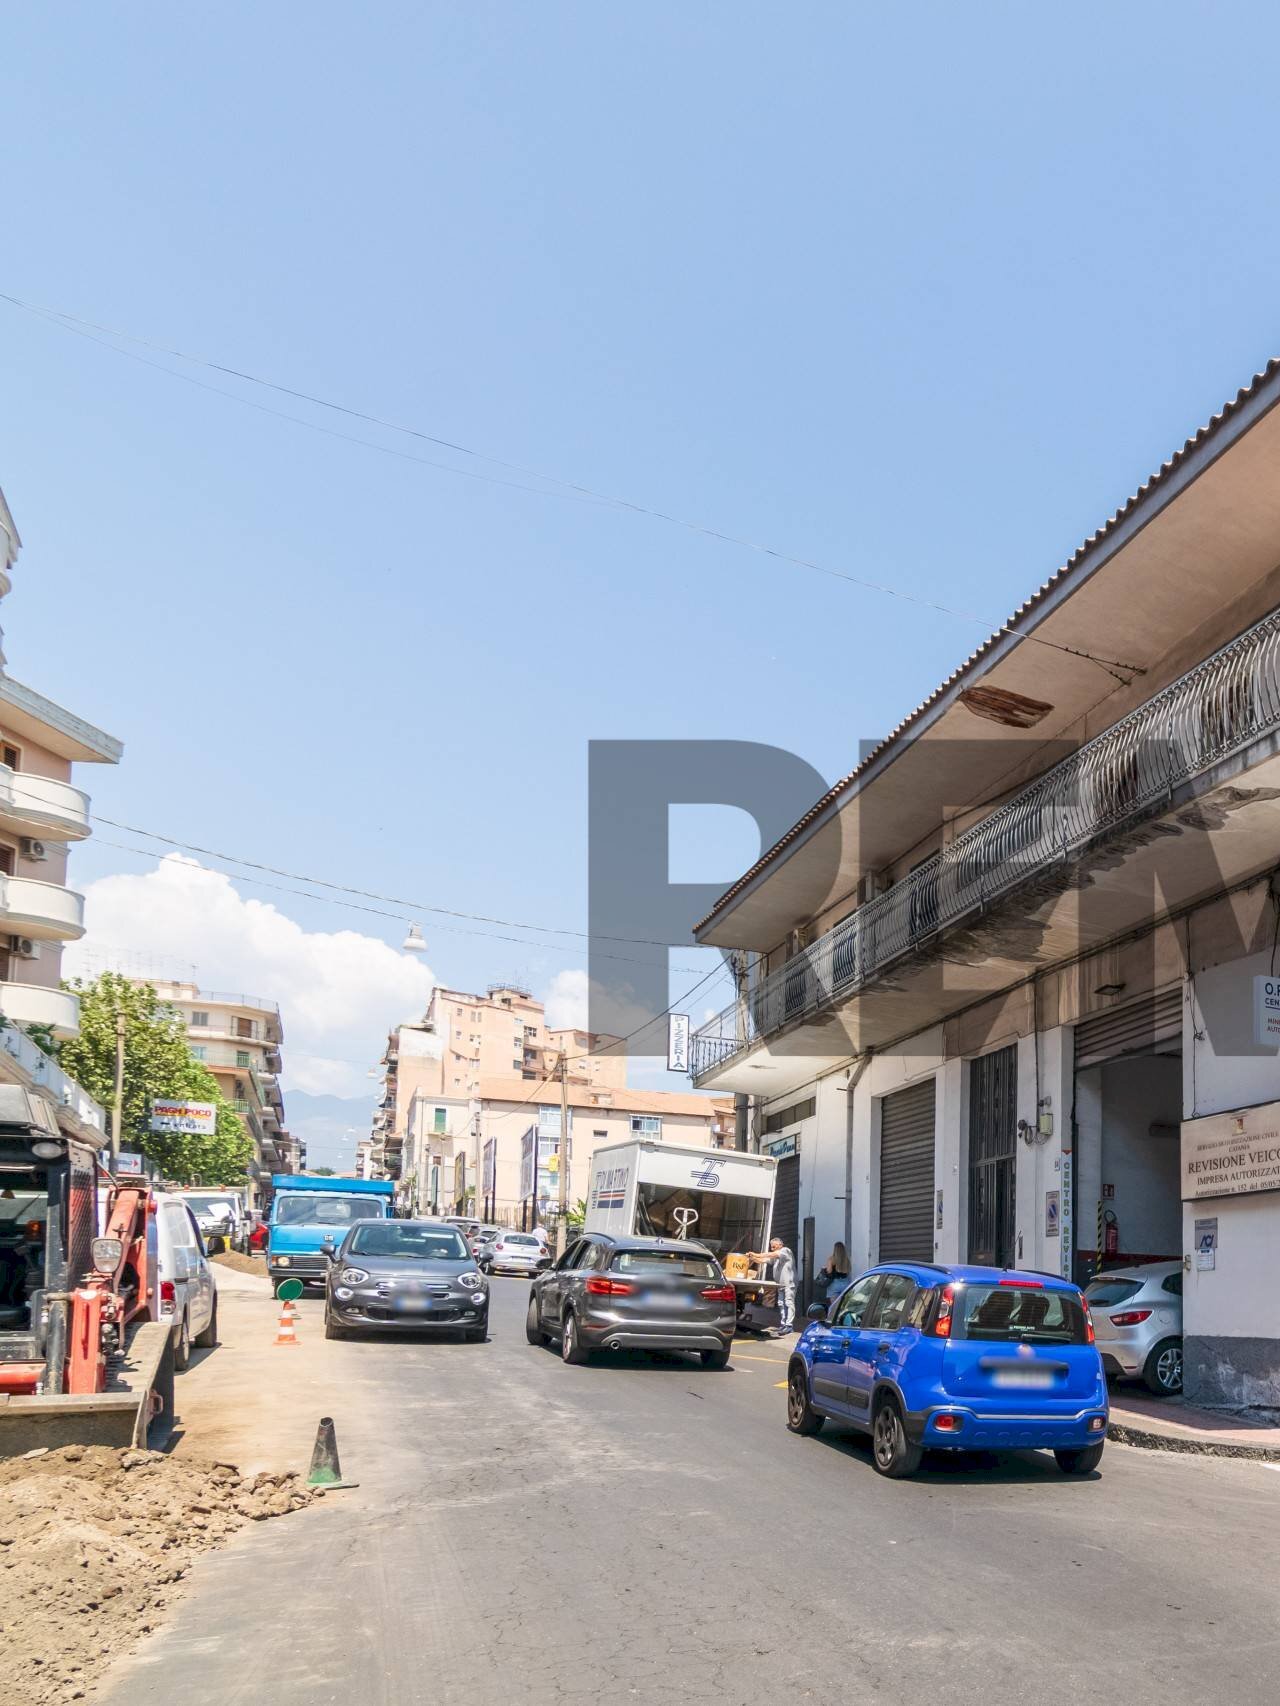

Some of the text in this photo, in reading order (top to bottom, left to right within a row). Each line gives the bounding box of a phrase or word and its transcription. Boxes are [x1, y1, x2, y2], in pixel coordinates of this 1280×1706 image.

[673, 1015, 685, 1069] PIZZERIA
[1188, 1154, 1246, 1174] REVISIONE
[1197, 1172, 1229, 1186] IMPRESA
